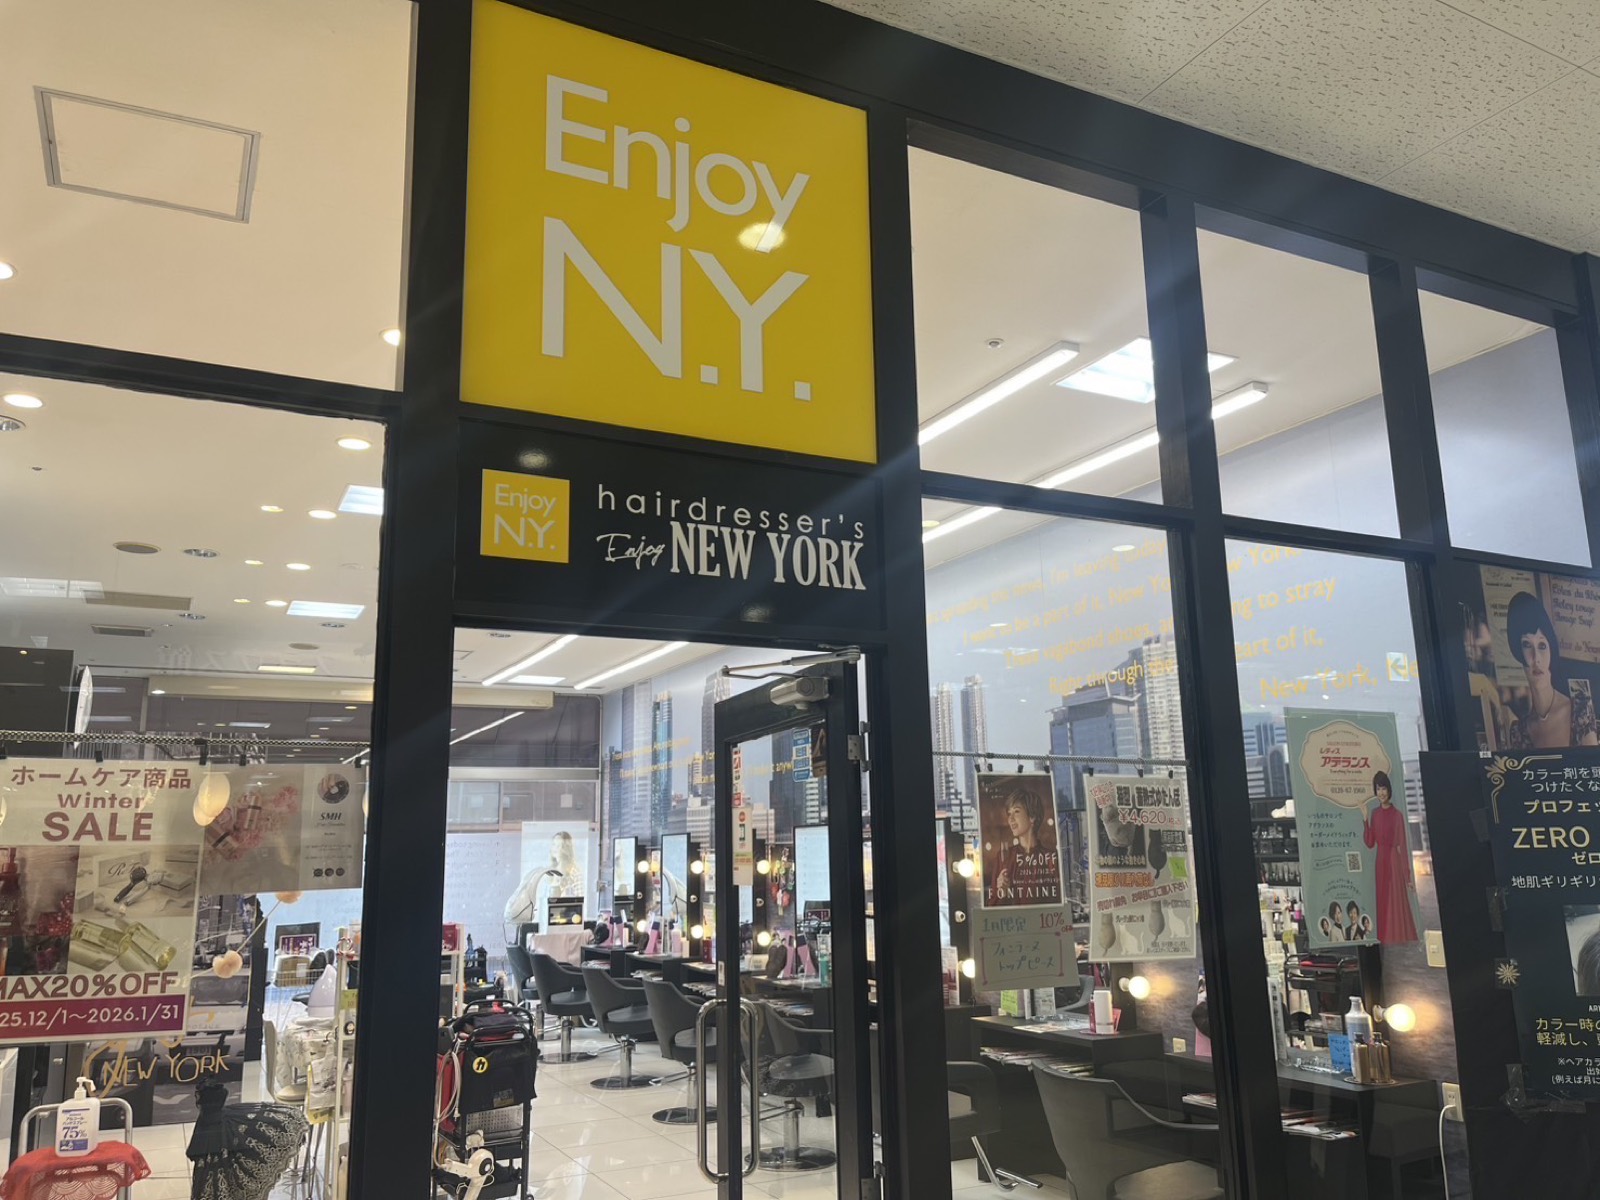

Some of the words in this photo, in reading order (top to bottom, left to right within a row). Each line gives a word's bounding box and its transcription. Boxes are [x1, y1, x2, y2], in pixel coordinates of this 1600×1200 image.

[545, 74, 811, 254] Enjoy
[541, 215, 812, 402] N.Y.
[494, 483, 557, 517] Enjoy
[597, 483, 865, 540] hairdresser's
[493, 515, 558, 551] N.Y.
[596, 532, 666, 570] Enjoy
[669, 521, 756, 580] NEW
[766, 531, 867, 592] YORK
[1258, 590, 1280, 611] to
[1285, 576, 1337, 602] stray
[1276, 625, 1299, 652] of
[1087, 658, 1144, 685] through
[1259, 676, 1310, 701] New
[1320, 756, 1371, 769] アデランス
[10, 766, 192, 790] ホームケア商品
[57, 791, 147, 809] Winter
[42, 811, 154, 843] SALE
[1511, 826, 1590, 849] ZERO
[1015, 851, 1059, 868] 5%OFF
[987, 885, 1058, 900] FONTAINE
[1039, 912, 1066, 930] 10%
[101, 1055, 158, 1087] NEW
[166, 1049, 231, 1083] YORK
[61, 1126, 88, 1139] 75%
